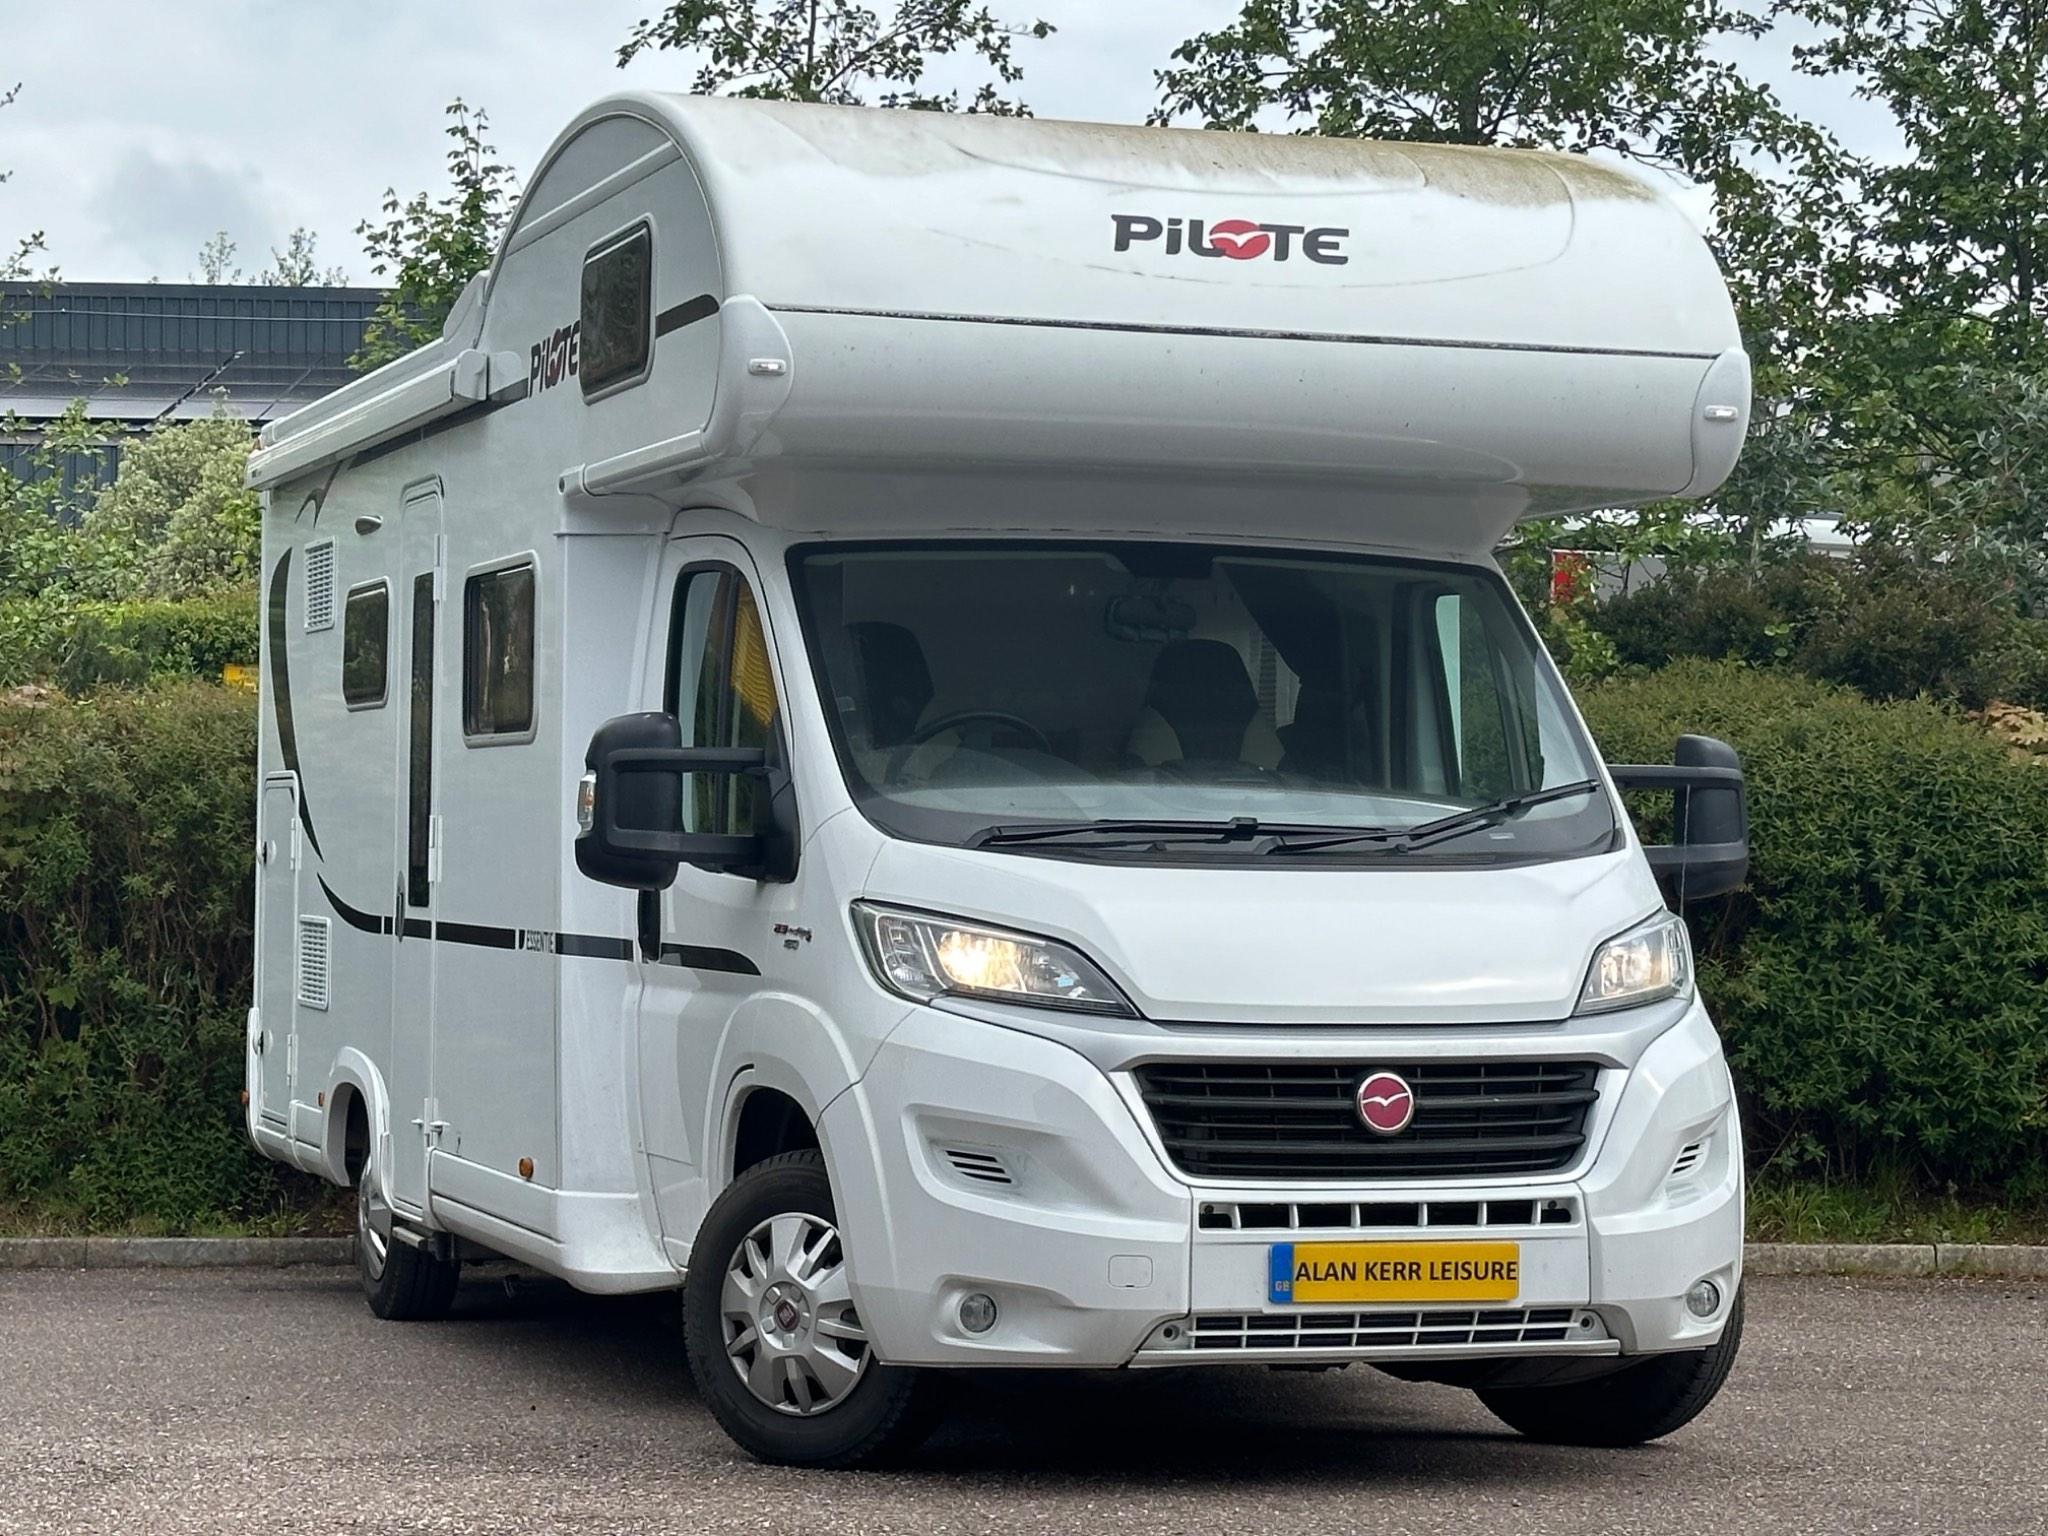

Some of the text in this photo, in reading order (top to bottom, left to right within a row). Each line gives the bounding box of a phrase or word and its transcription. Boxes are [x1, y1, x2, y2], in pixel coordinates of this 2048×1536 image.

[1295, 1261, 1518, 1281] ALAN KERR LEISURE
[1275, 1280, 1290, 1292] GB
